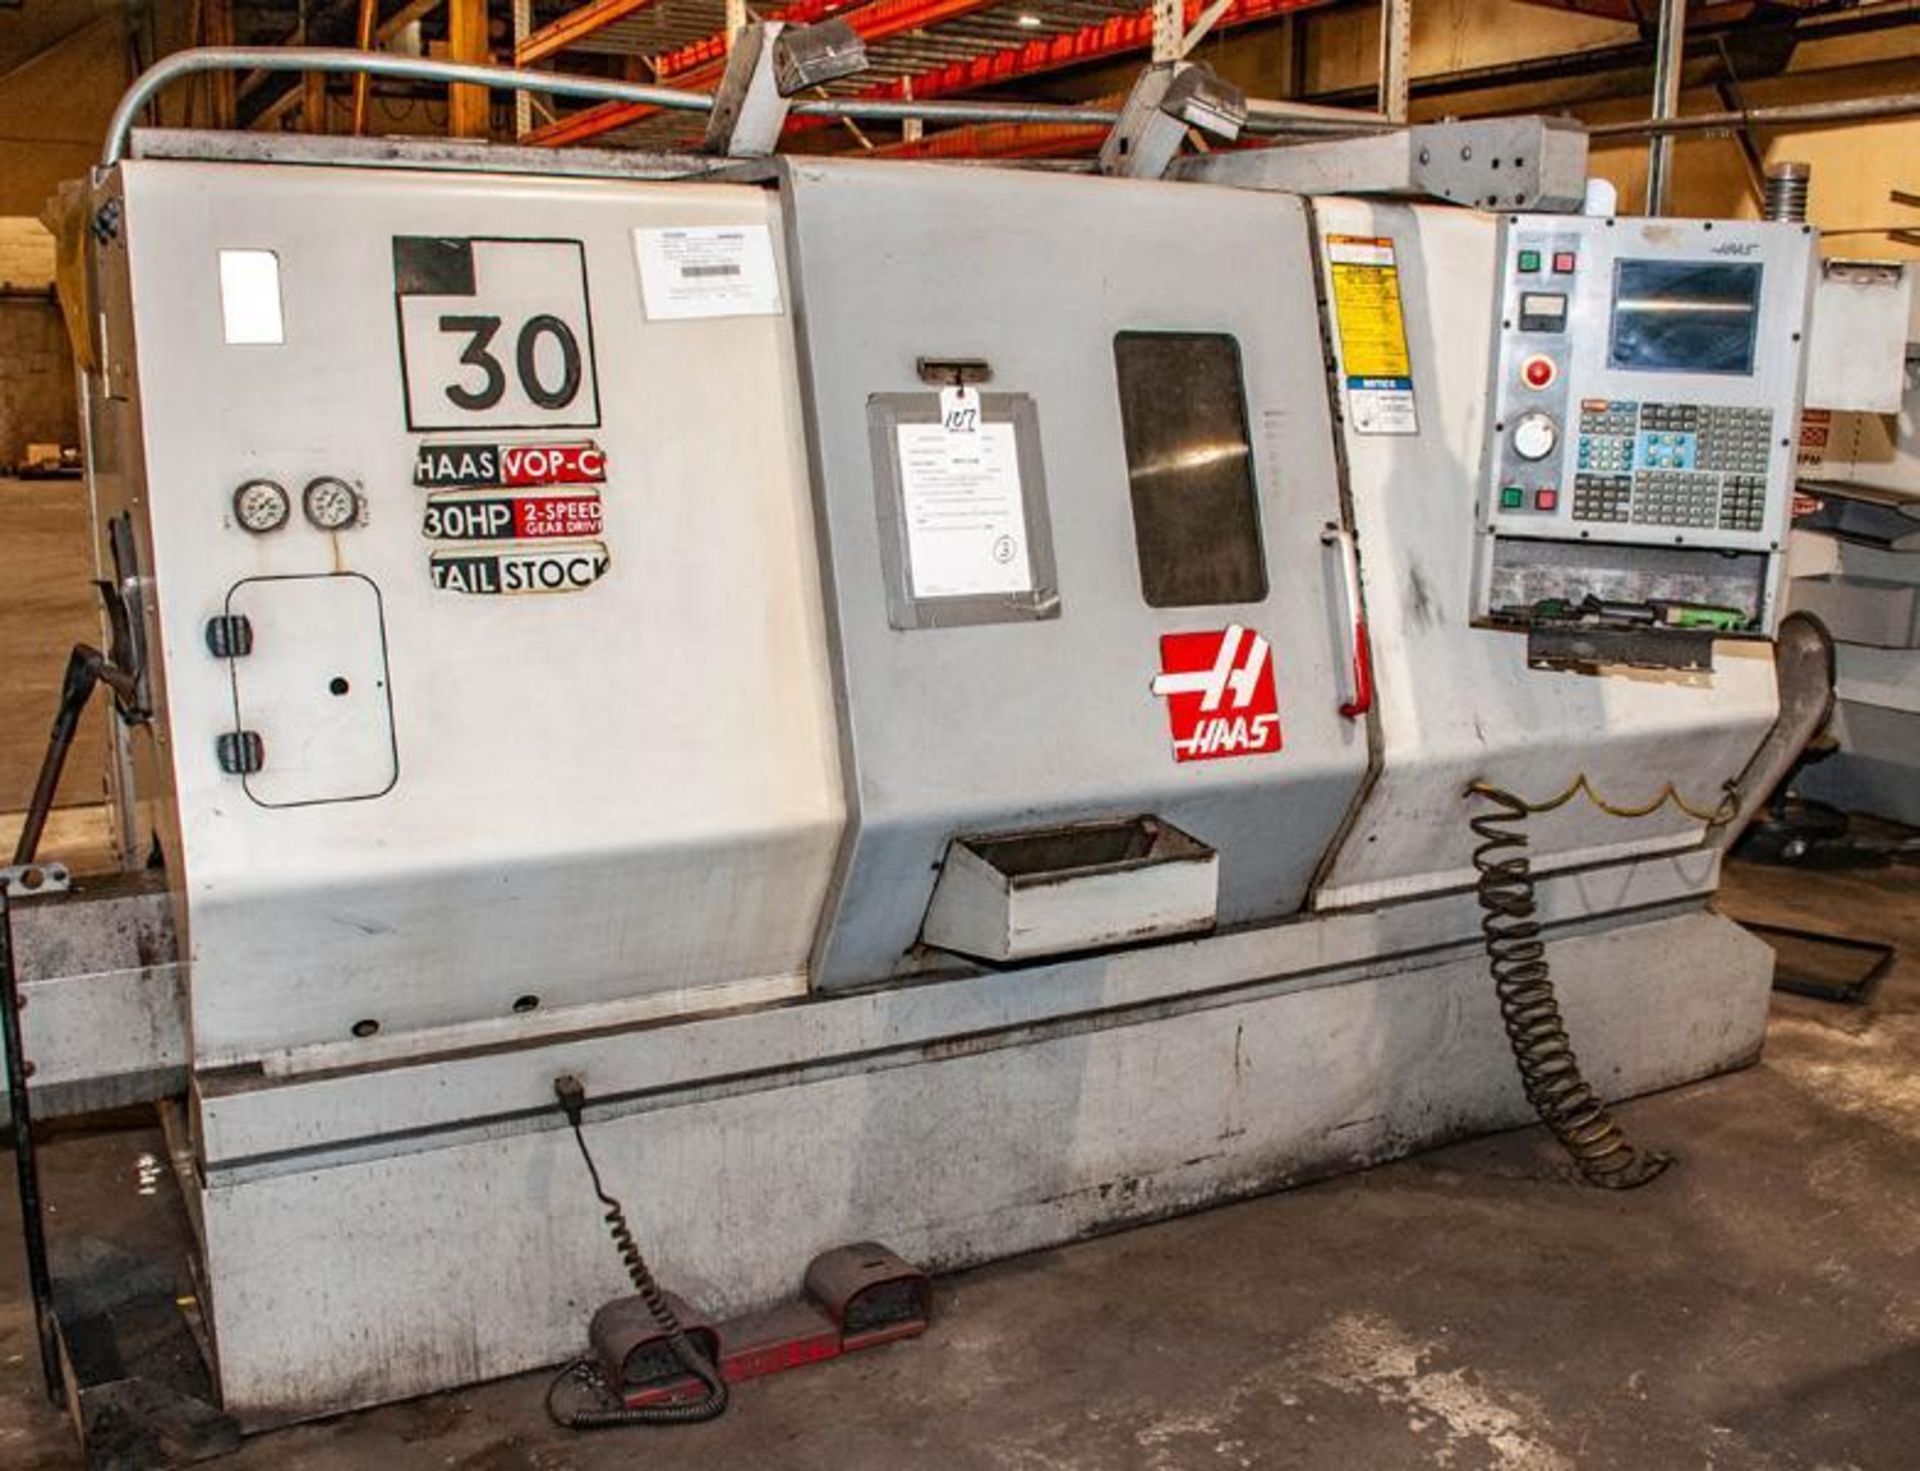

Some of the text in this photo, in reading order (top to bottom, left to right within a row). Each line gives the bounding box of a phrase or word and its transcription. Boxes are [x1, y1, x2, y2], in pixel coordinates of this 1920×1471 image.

[439, 313, 583, 411] 30
[417, 450, 601, 479] HAAS VOP-C
[425, 504, 511, 537] 30HP
[524, 502, 601, 521] 2-SPEED
[525, 521, 563, 535] GEAR
[431, 562, 495, 592] TAIL
[1174, 713, 1279, 755] HAAS
